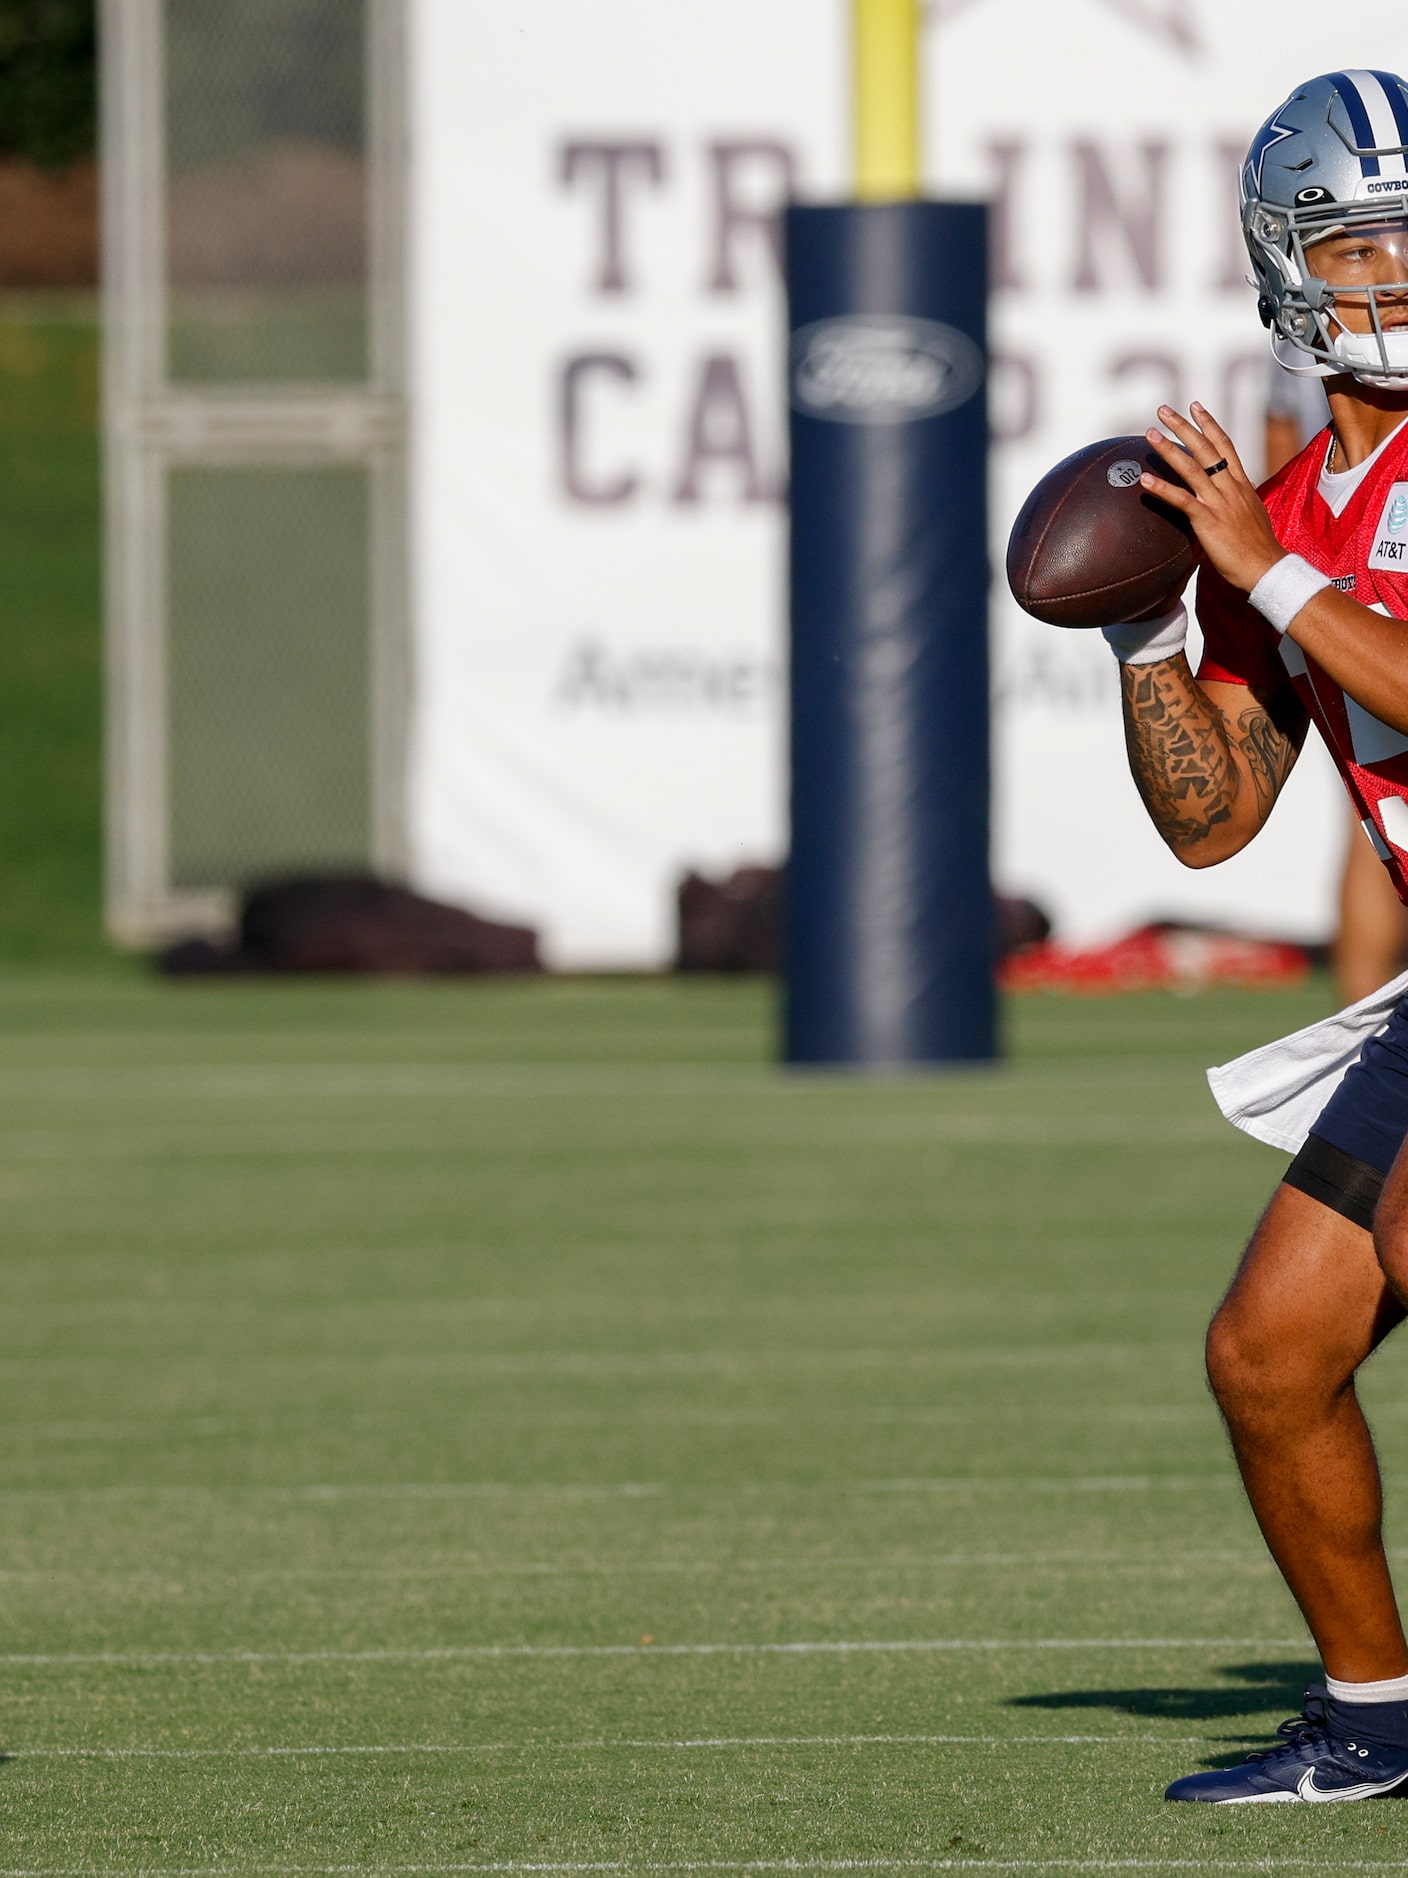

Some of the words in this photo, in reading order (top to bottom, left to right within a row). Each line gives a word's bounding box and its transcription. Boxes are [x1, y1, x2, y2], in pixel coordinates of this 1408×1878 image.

[555, 348, 1040, 511] CAP
[1120, 468, 1140, 485] 072
[1375, 540, 1407, 560] AT&T
